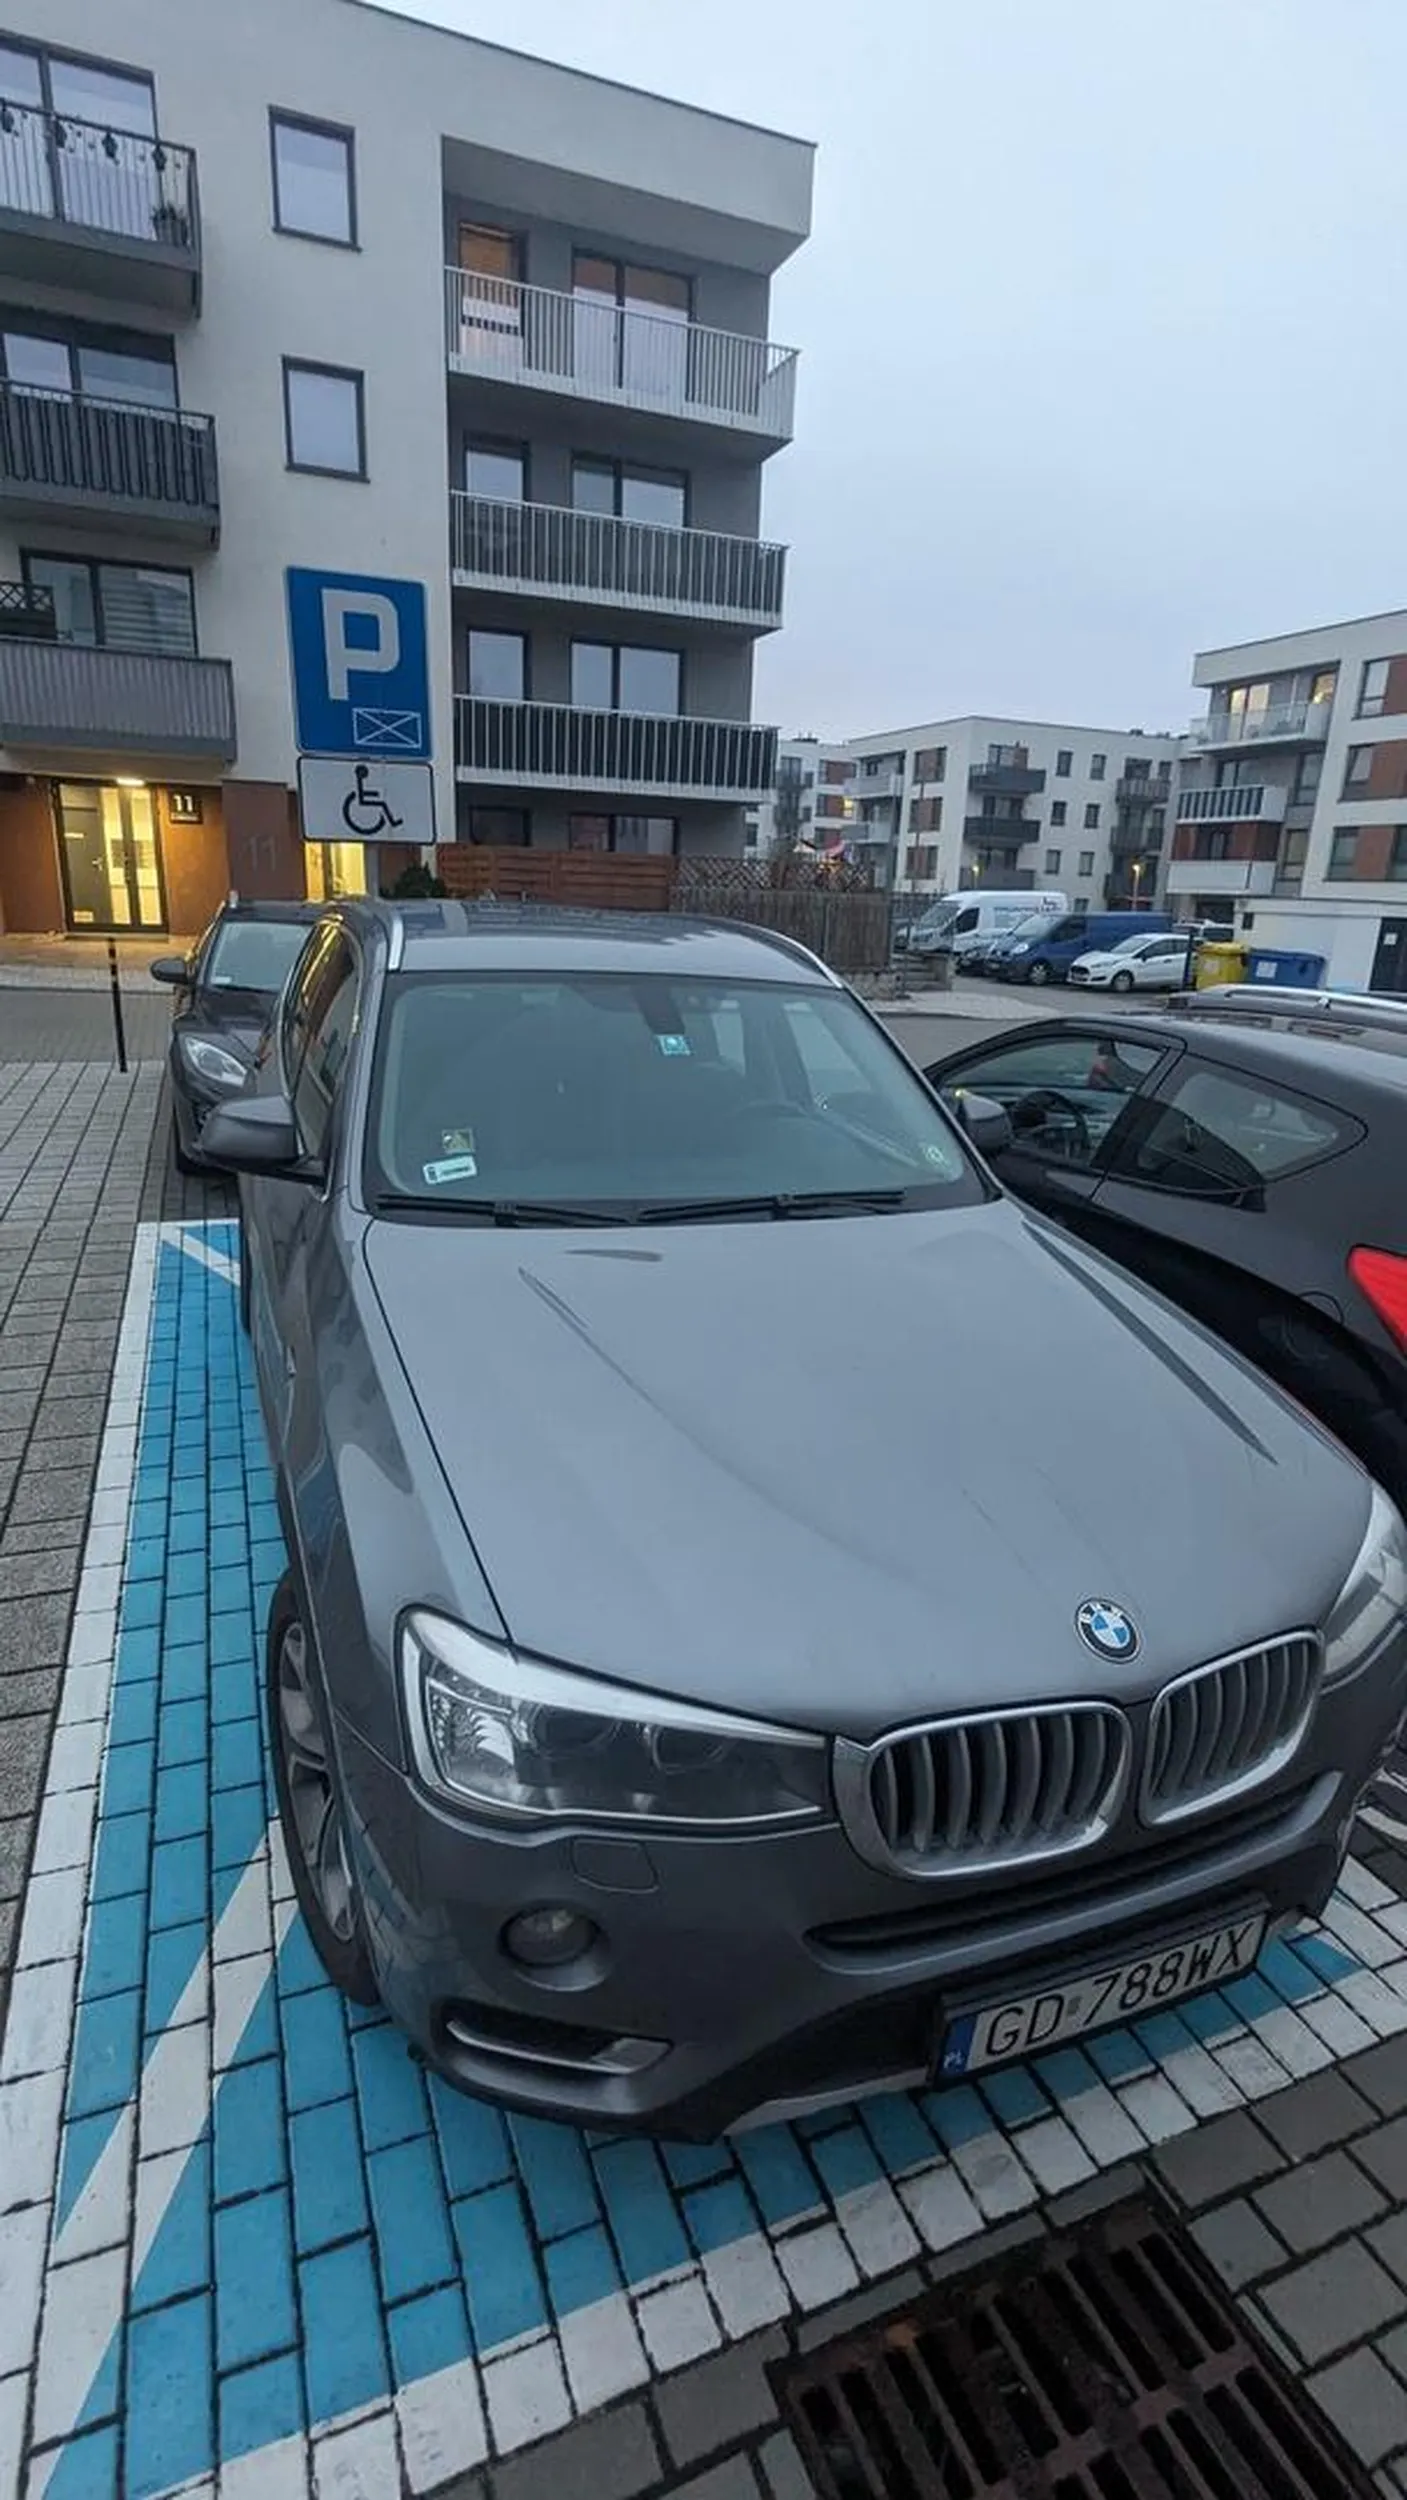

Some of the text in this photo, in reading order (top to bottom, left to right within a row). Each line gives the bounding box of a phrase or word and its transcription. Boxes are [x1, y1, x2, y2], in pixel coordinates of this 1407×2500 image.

[321, 587, 400, 701] P
[173, 794, 194, 812] 11
[242, 836, 276, 871] 11
[985, 1922, 1255, 2056] GD 788WX
